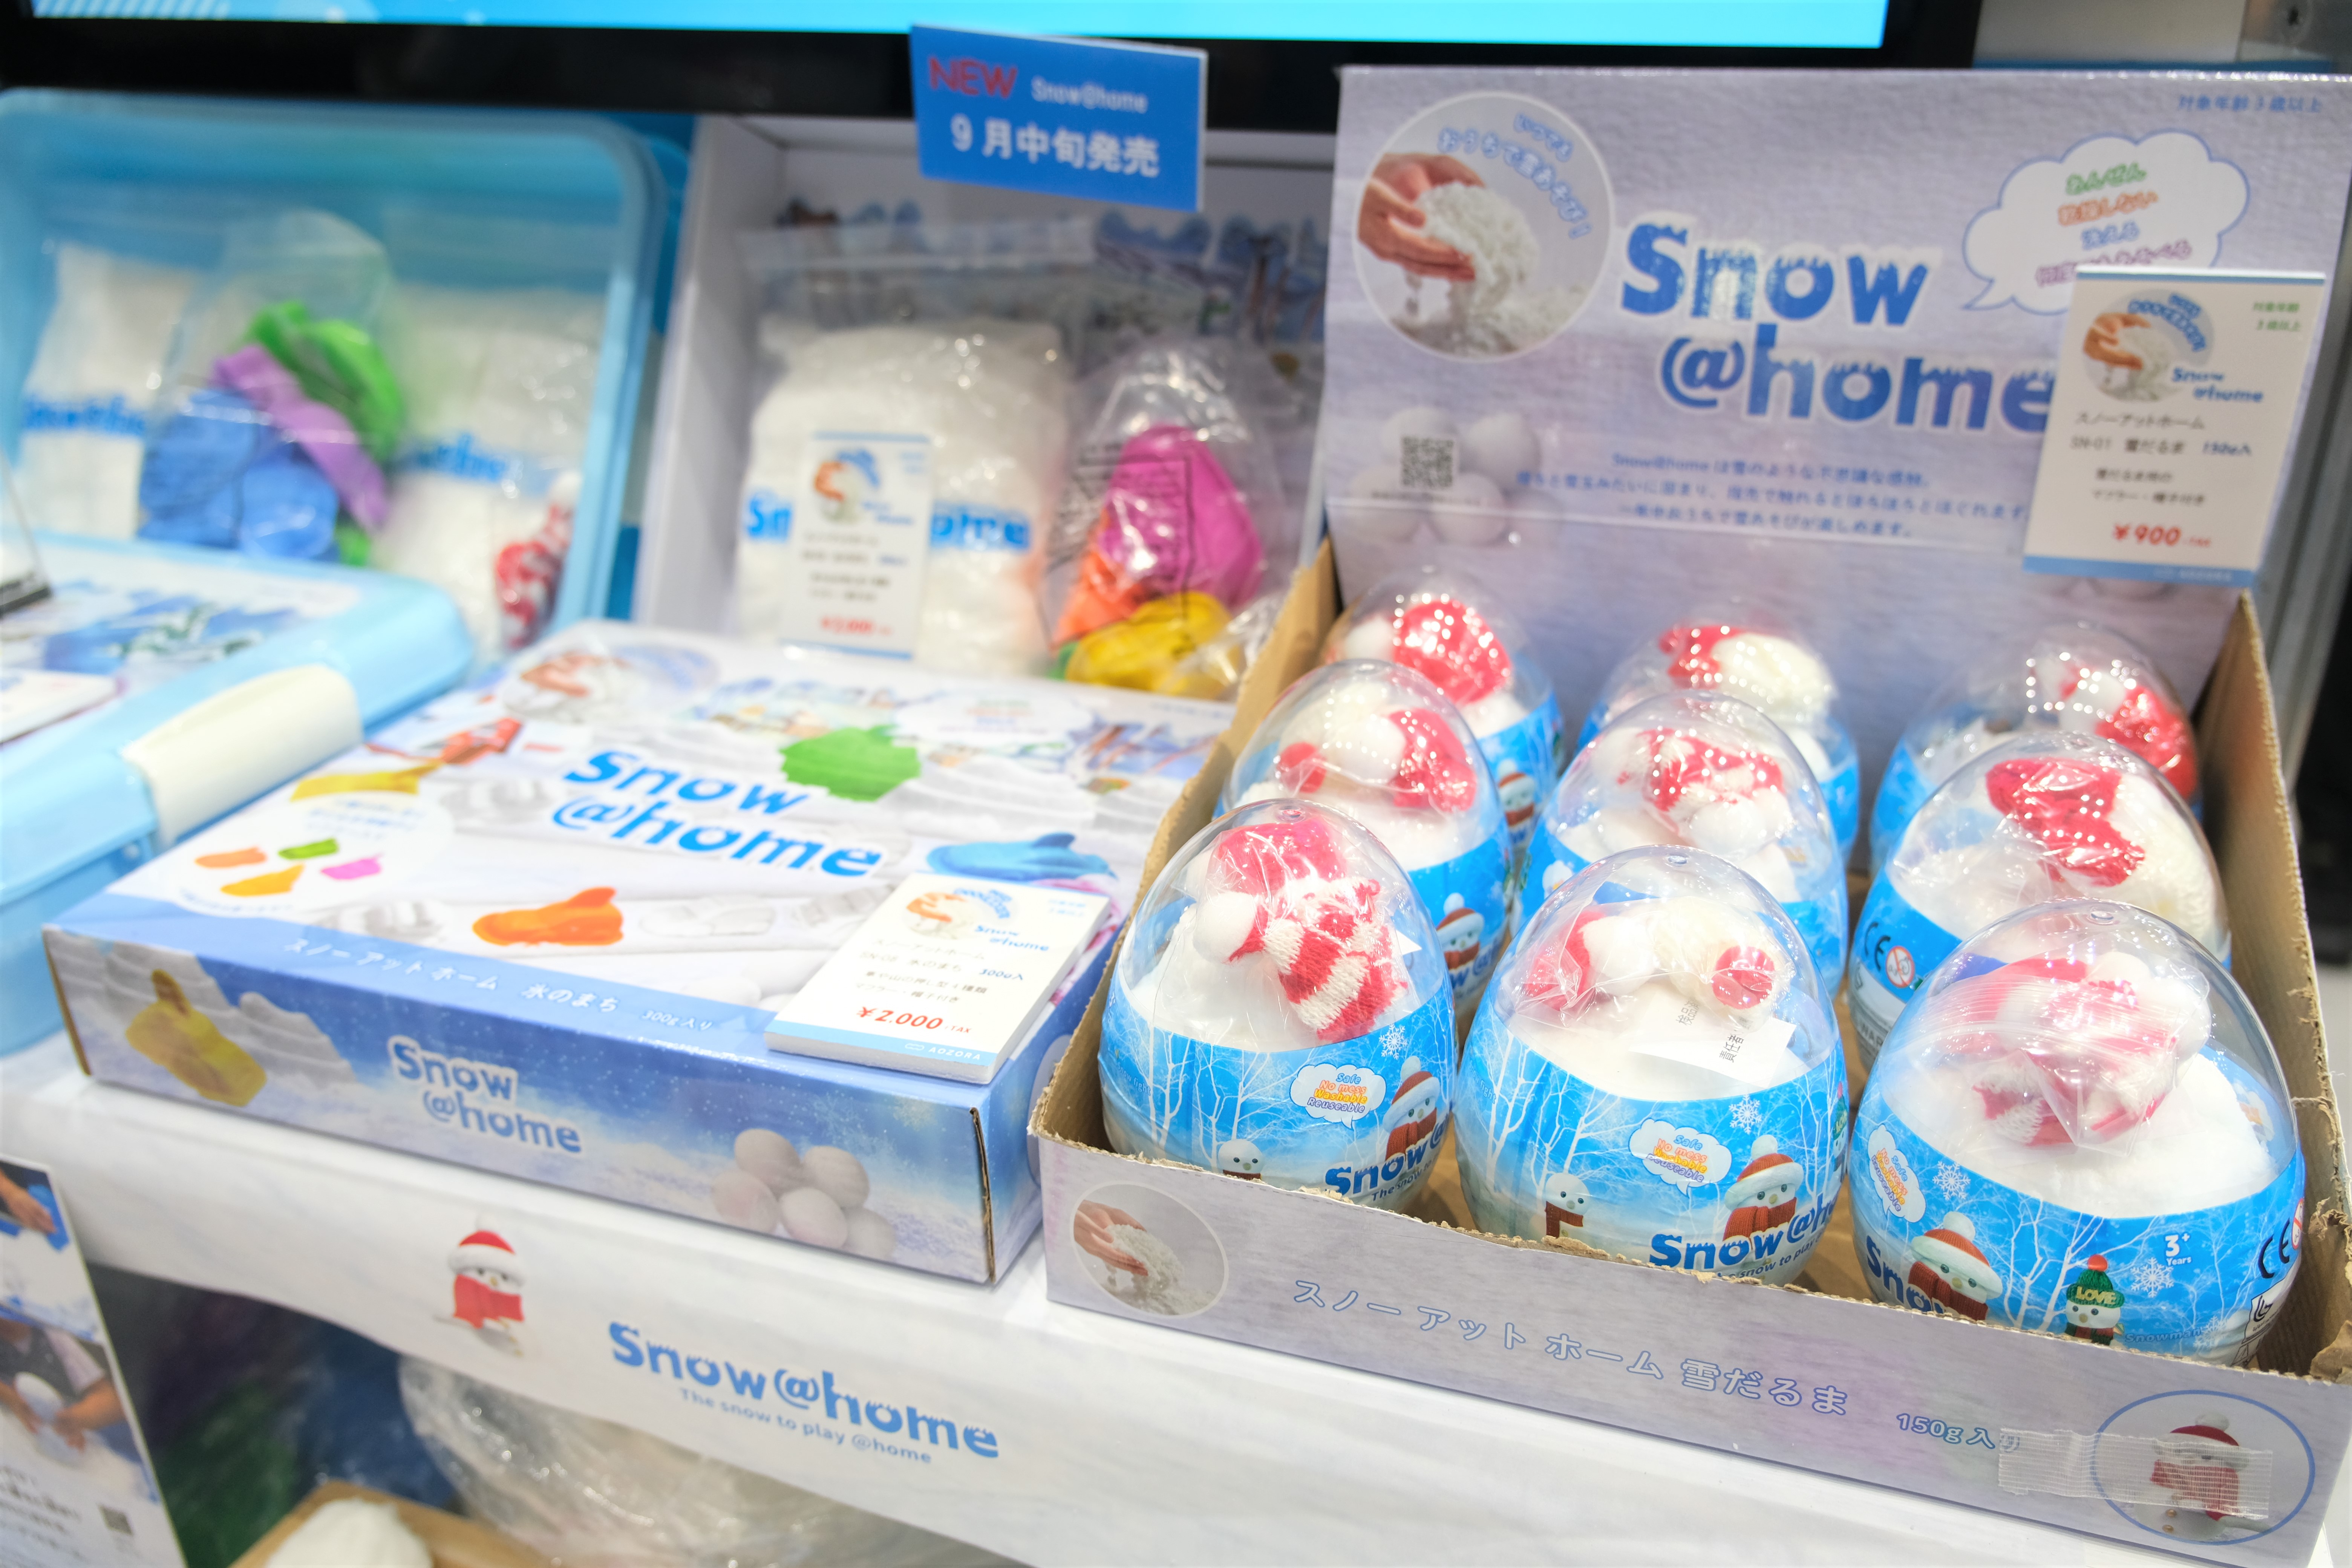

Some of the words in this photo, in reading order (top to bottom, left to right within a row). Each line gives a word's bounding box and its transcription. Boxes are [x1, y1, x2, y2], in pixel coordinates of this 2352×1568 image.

[928, 55, 1018, 100] NEW
[1031, 76, 1149, 115] Snow@home
[1622, 222, 1929, 326] Snow
[1660, 322, 2055, 433] @home
[563, 751, 809, 816] Snow
[553, 796, 882, 877] @home
[392, 1039, 515, 1101] Snow
[928, 1047, 980, 1060] AOZORA
[1117, 1061, 1132, 1081] Snow
[1133, 1077, 1151, 1096] fight
[1314, 1088, 1367, 1104] Washable
[1320, 1080, 1334, 1090] No
[1338, 1083, 1367, 1094] mess
[1336, 1073, 1361, 1084] Safe
[1480, 1079, 1496, 1104] fight
[423, 1089, 583, 1154] @home
[1307, 1097, 1365, 1113] Reuseable
[1325, 1118, 1447, 1195] Snow@
[1653, 1146, 1707, 1173] Washable
[1658, 1138, 1672, 1151] No
[1675, 1147, 1707, 1162] mess
[1674, 1134, 1703, 1151] Safe
[1372, 1186, 1394, 1201] The
[1396, 1171, 1422, 1189] snow
[1871, 1155, 1901, 1211] Reuseable
[1876, 1150, 1905, 1205] Washable
[1880, 1148, 1889, 1164] No
[1888, 1166, 1908, 1195] mess
[1891, 1156, 1908, 1182] Safe
[1739, 1264, 1774, 1279] snow
[1779, 1256, 1791, 1266] to
[1794, 1242, 1815, 1262] play
[2165, 1256, 2191, 1267] Years
[2076, 1286, 2116, 1306] LOVE
[2125, 1328, 2202, 1343] Snowman
[609, 1321, 999, 1458] Snow@home
[1681, 1358, 1847, 1416] 雪だるま
[679, 1387, 715, 1409] The
[720, 1401, 771, 1425] snow
[777, 1413, 797, 1431] to
[803, 1420, 845, 1446] play
[853, 1433, 932, 1463] @home
